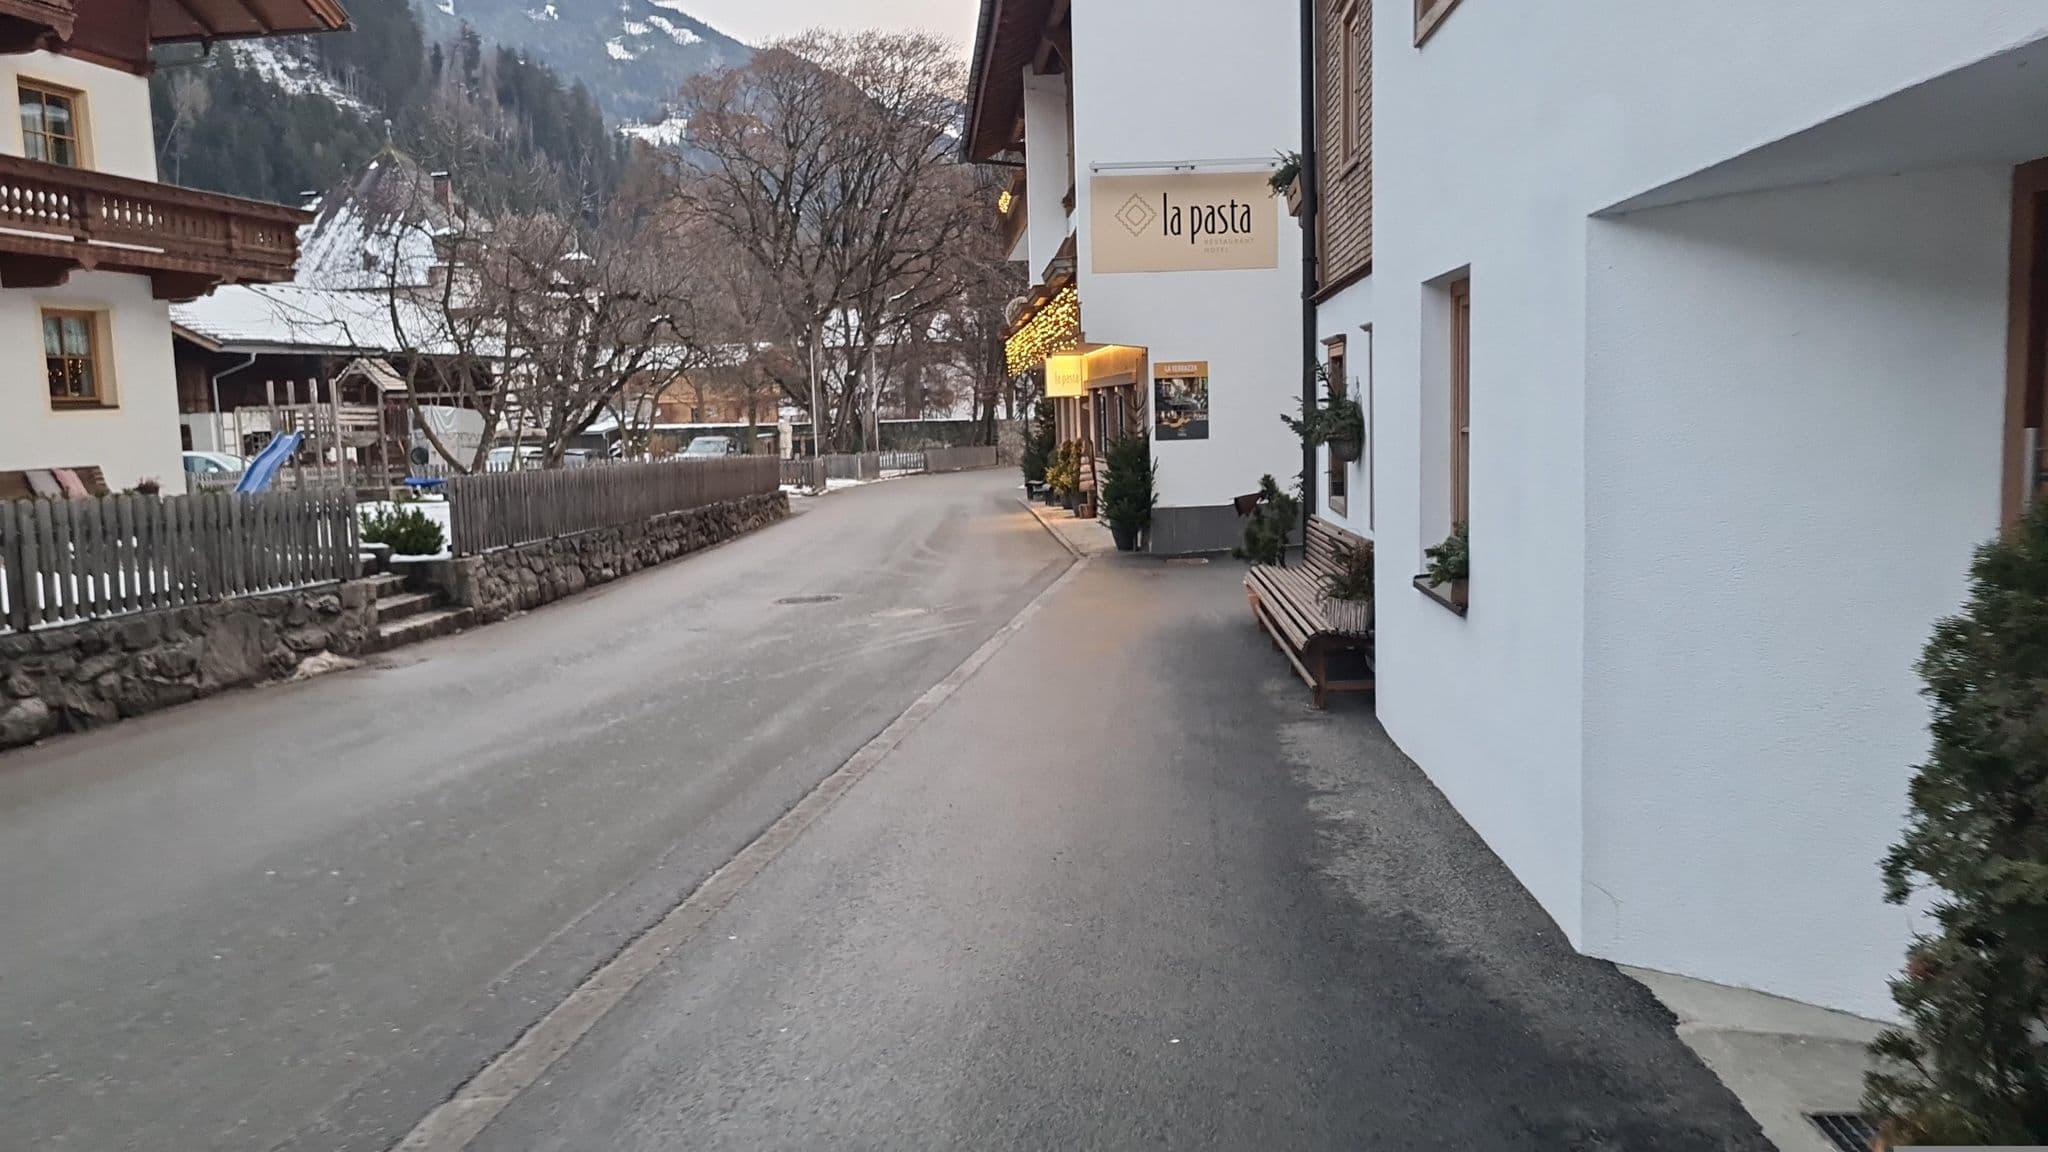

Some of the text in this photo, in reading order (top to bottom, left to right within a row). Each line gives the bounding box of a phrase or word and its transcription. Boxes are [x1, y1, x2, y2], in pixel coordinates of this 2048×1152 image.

[1163, 192, 1251, 244] la pasta
[1061, 372, 1079, 386] pasta
